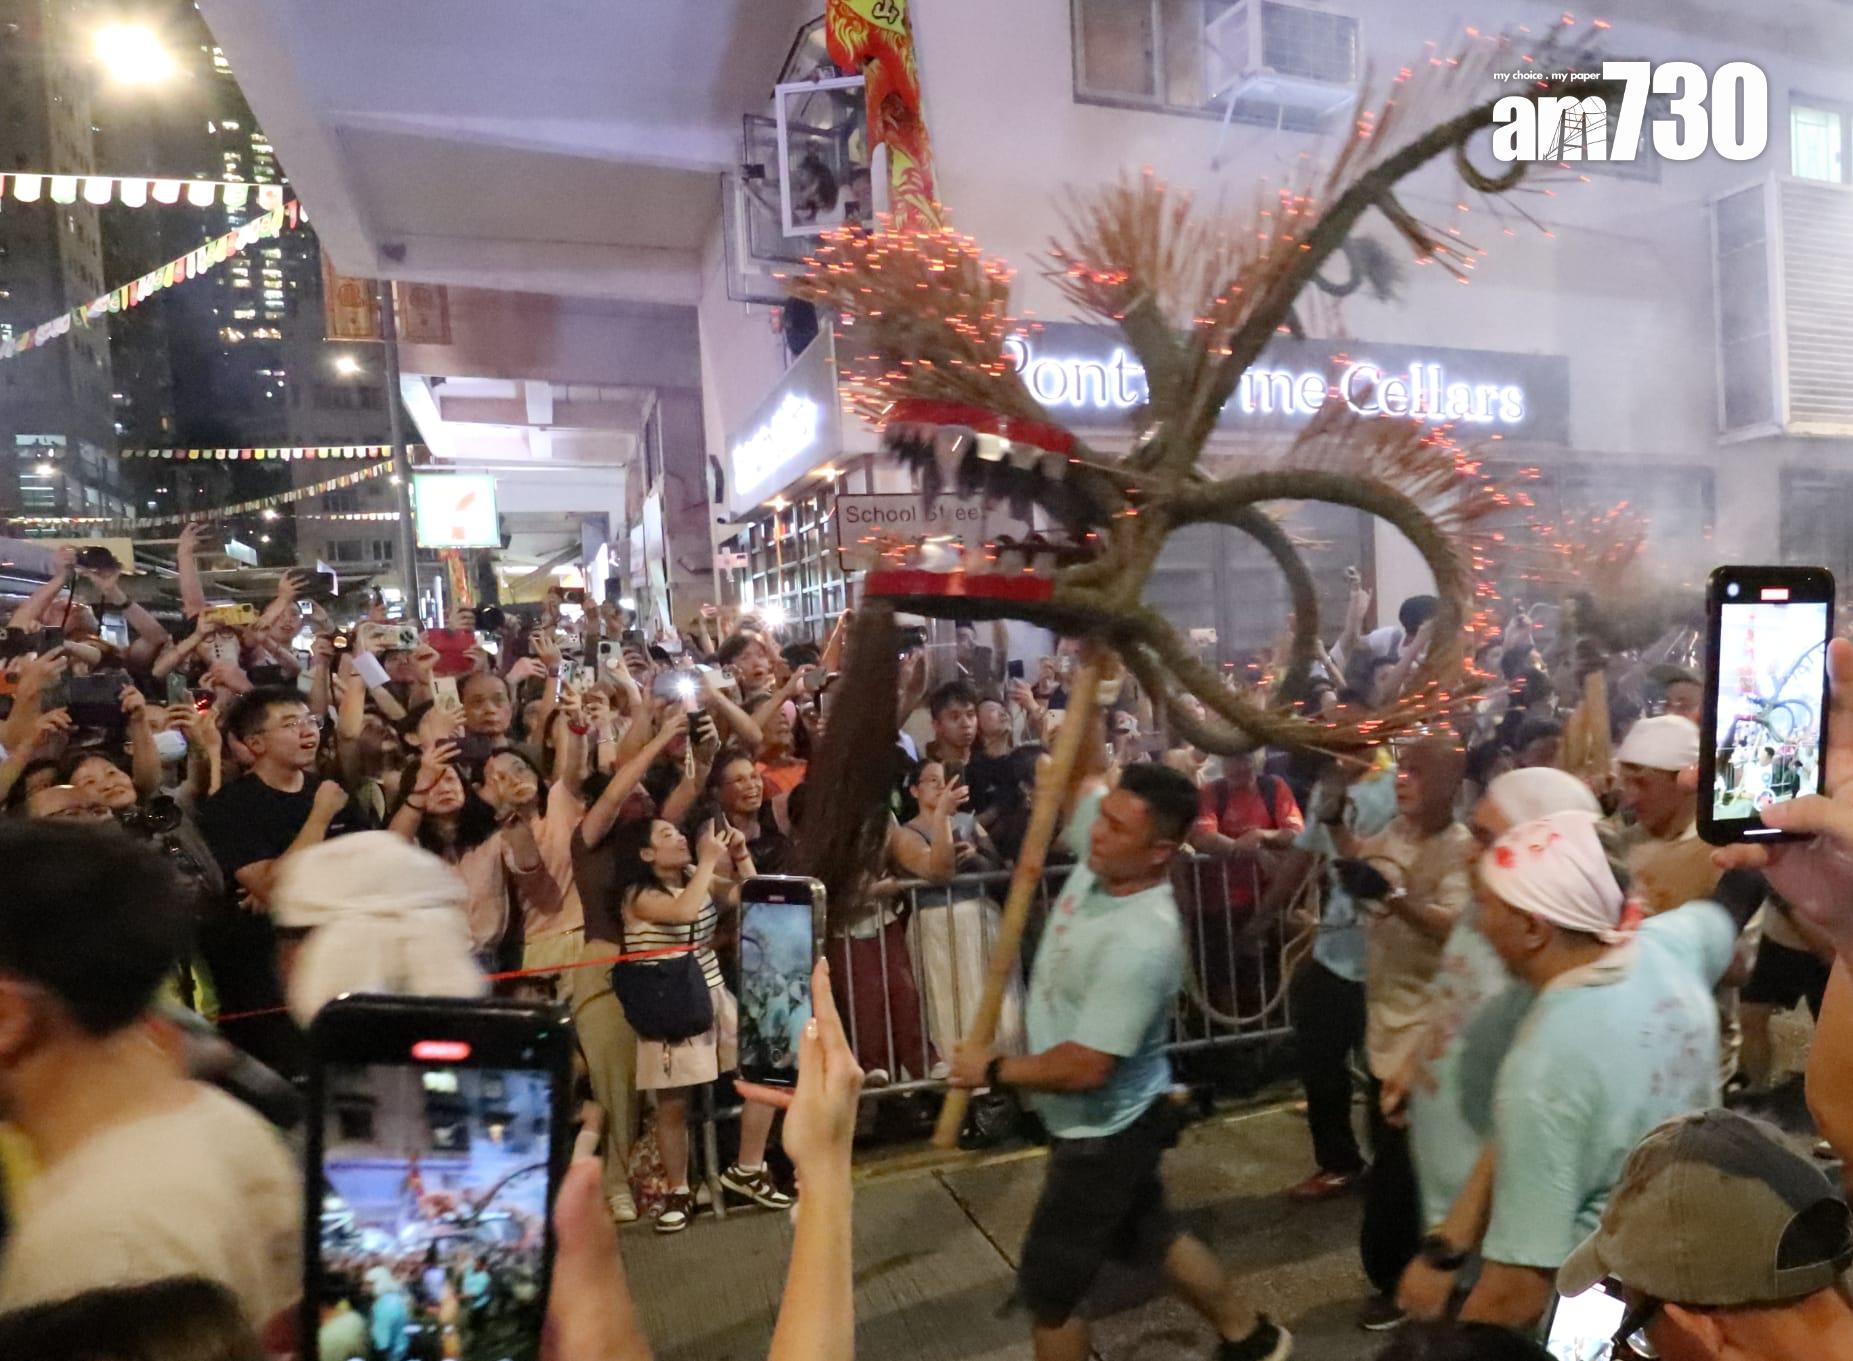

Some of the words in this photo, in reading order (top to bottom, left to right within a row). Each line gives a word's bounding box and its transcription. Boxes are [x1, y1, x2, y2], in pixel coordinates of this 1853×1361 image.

[1004, 335, 1149, 405] Pont
[1239, 368, 1327, 413] ine
[1341, 361, 1525, 421] Cellars
[846, 505, 916, 523] School
